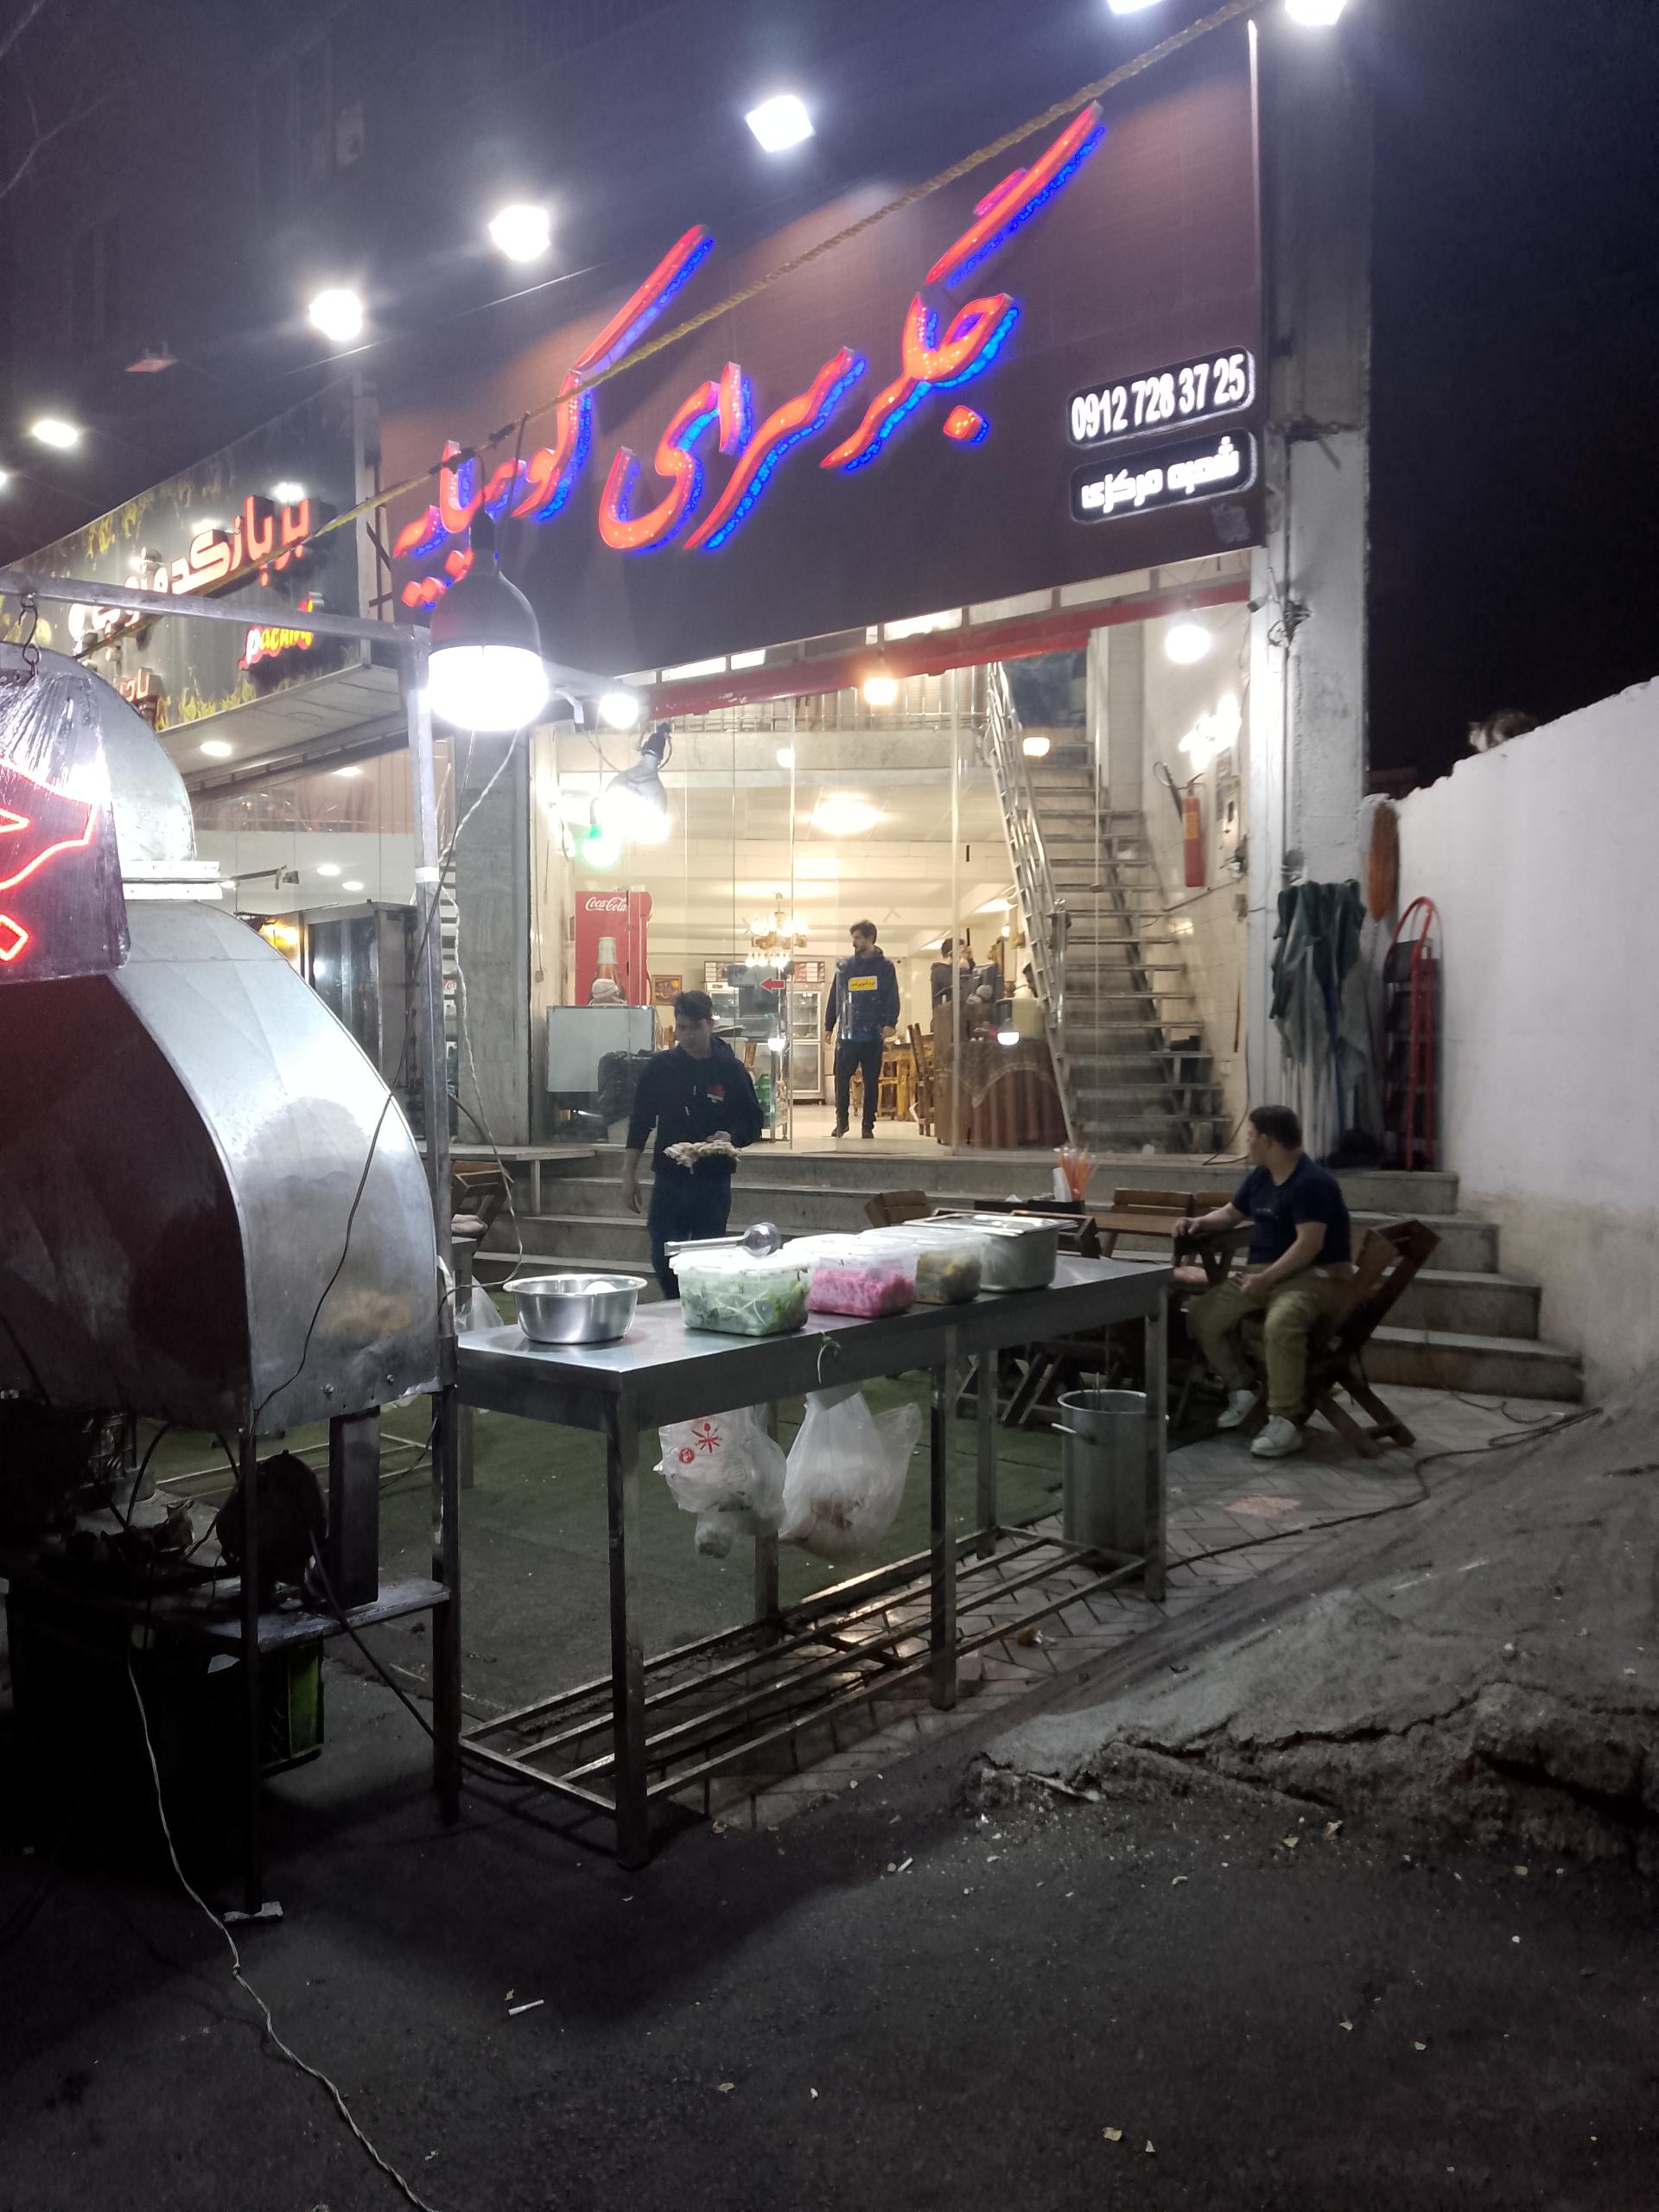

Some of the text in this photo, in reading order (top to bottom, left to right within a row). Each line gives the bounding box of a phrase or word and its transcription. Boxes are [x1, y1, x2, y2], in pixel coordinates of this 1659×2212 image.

[1071, 385, 1128, 441] 0912
[1179, 362, 1210, 414] 37
[1213, 353, 1246, 406] 25
[1081, 435, 1241, 513] شعبه مرکزی
